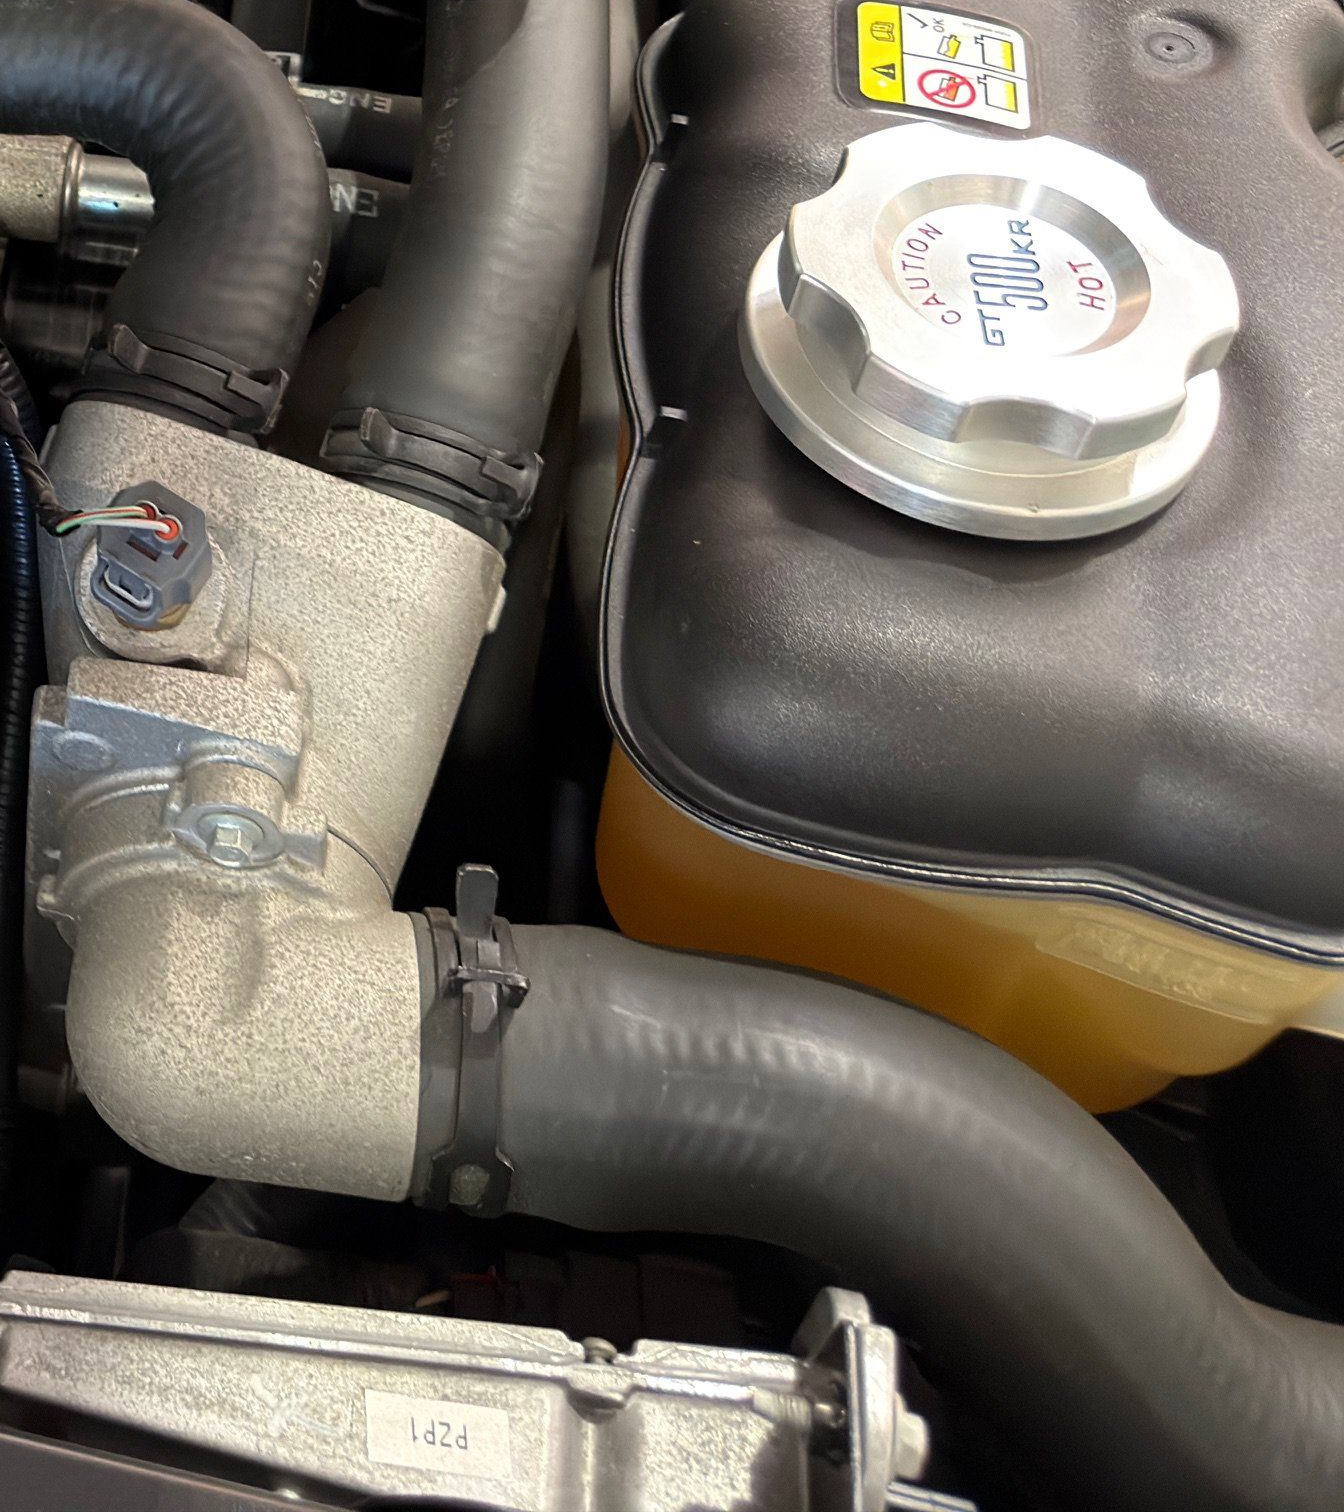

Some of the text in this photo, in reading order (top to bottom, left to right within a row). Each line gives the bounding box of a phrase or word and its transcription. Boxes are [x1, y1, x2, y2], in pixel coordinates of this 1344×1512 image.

[931, 16, 945, 33] OK
[895, 221, 961, 327] CAUTION
[966, 218, 1048, 347] GT500KR
[1065, 259, 1106, 313] HOT
[406, 1416, 472, 1452] PZP1
